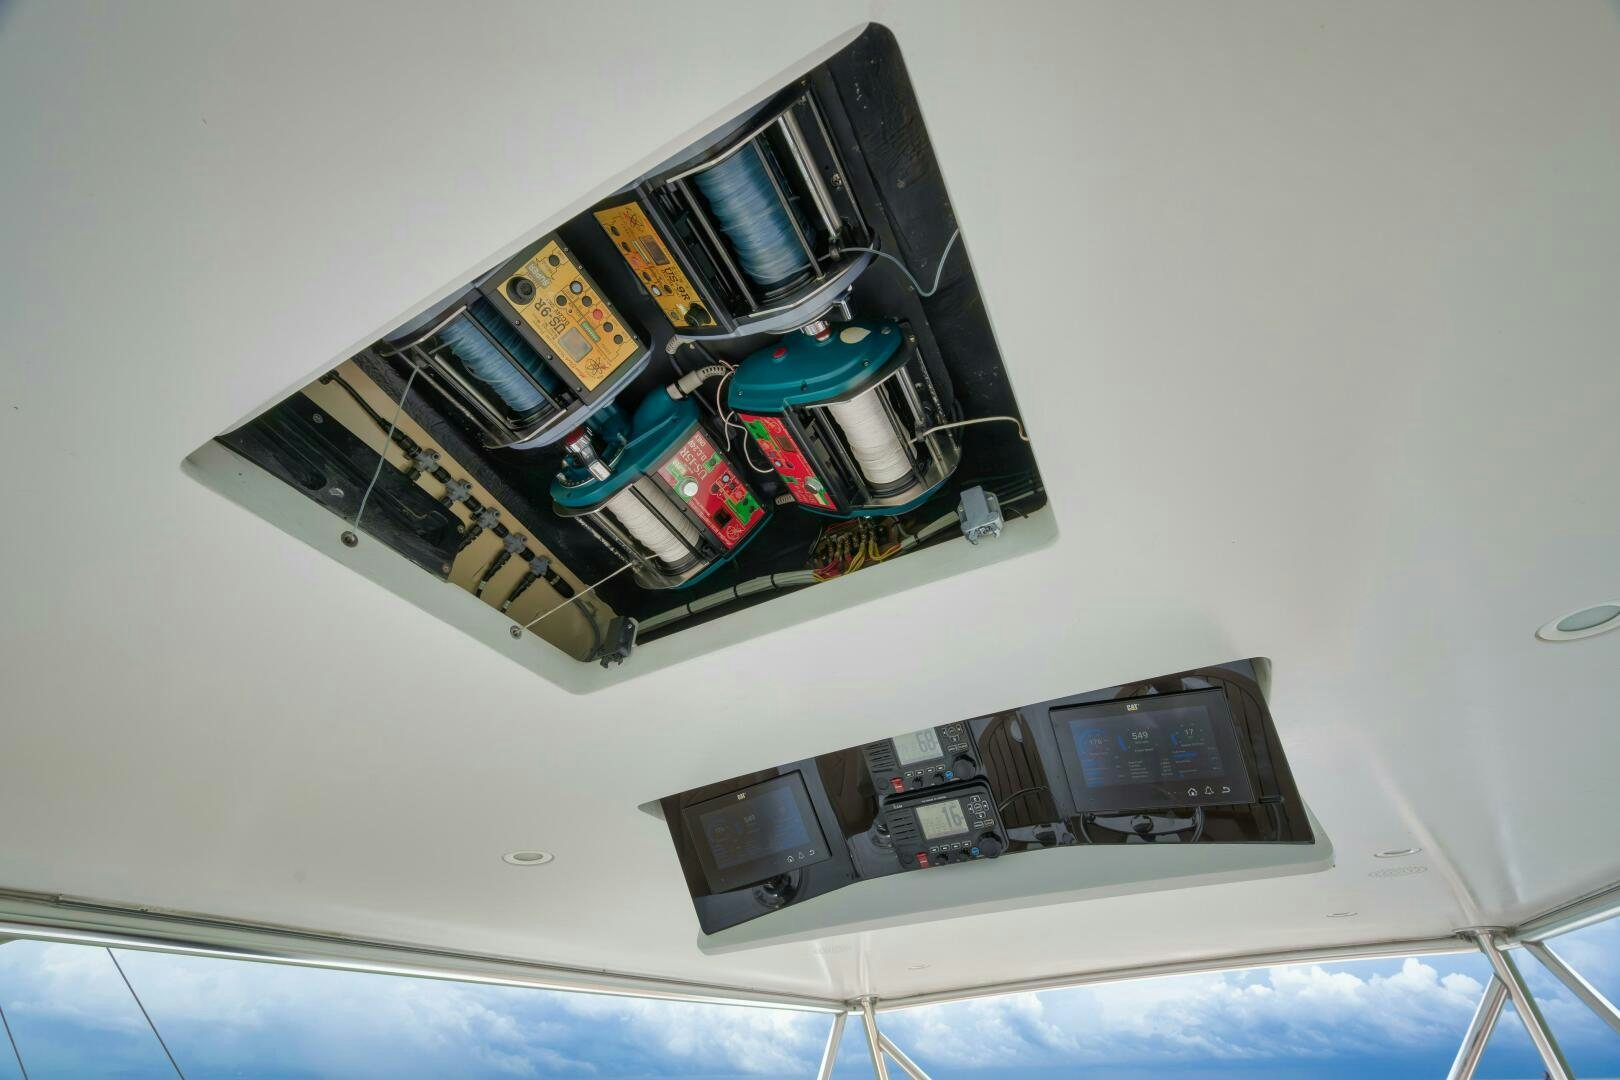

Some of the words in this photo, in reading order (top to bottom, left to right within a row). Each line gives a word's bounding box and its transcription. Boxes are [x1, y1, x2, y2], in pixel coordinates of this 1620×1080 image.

[533, 297, 566, 335] US-9R
[678, 447, 708, 480] US-15R
[916, 731, 938, 753] 68
[1131, 730, 1149, 741] 549
[941, 804, 962, 828] 16
